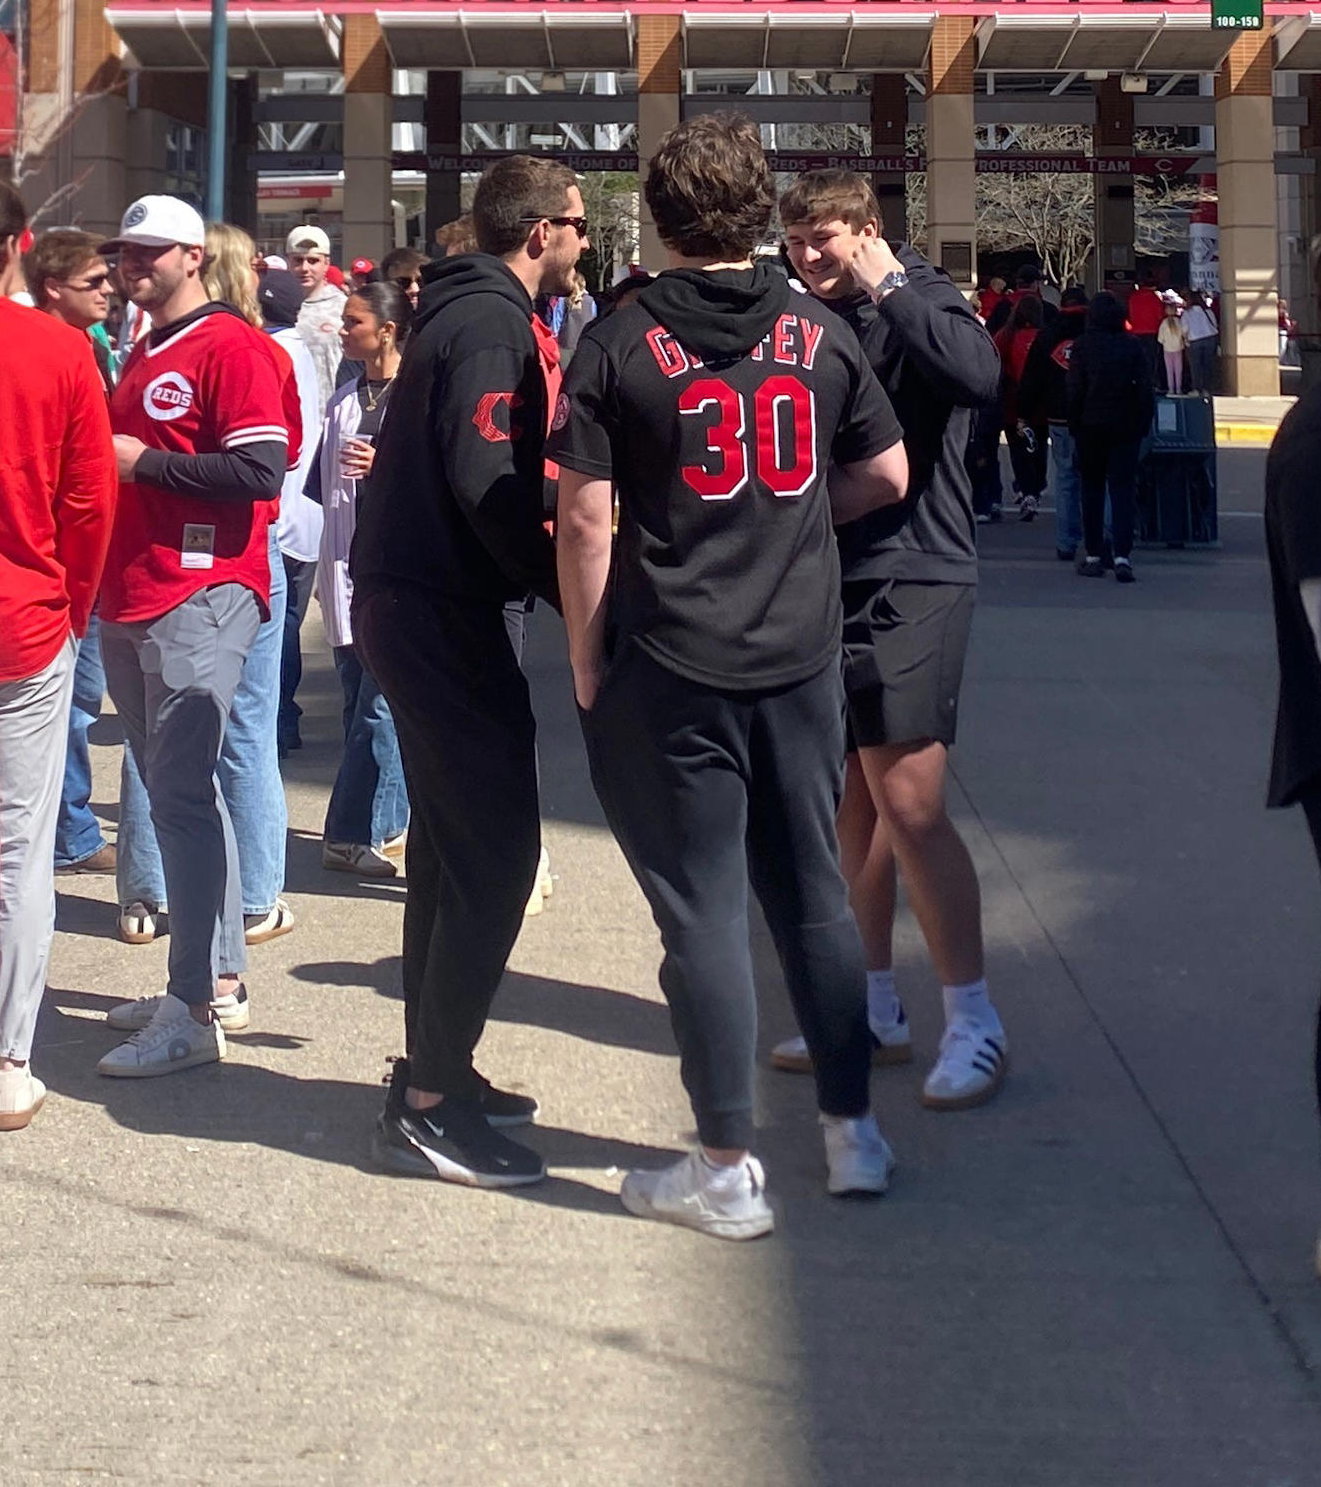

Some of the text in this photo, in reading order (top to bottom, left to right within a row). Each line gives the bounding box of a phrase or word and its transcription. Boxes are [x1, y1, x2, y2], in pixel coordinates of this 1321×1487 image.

[1216, 16, 1259, 27] 100-159
[1086, 158, 1131, 173] TEAM
[151, 386, 193, 407] REDS
[678, 375, 819, 502] 30
